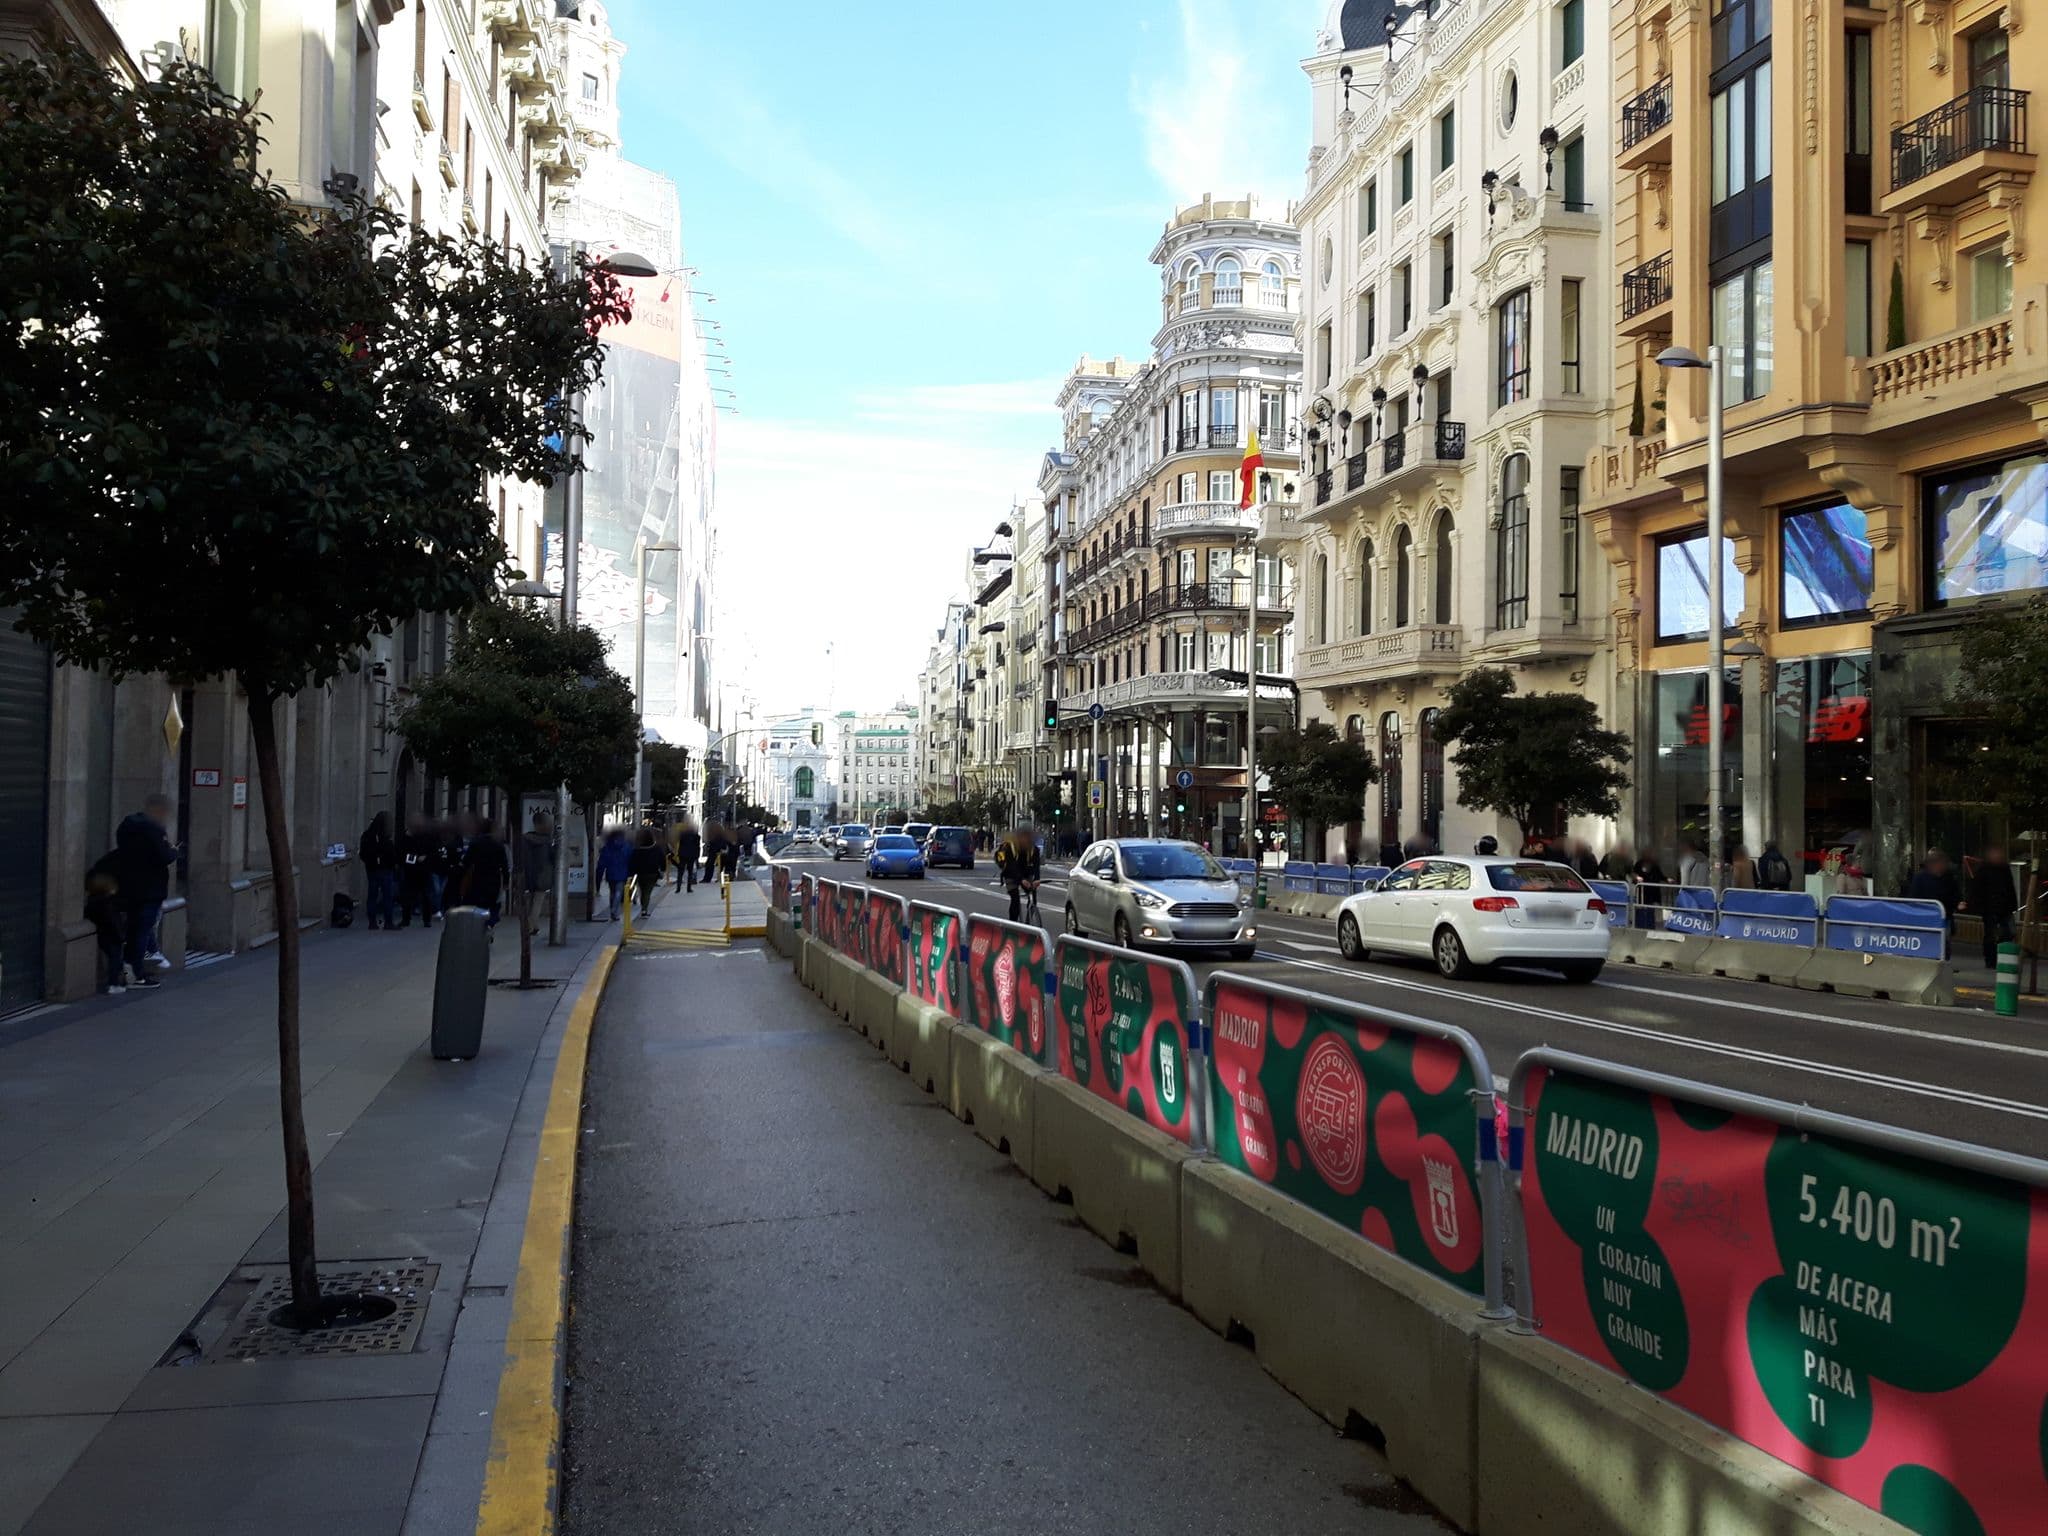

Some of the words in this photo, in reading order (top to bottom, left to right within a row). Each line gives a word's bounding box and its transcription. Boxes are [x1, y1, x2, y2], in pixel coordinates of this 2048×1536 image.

[1667, 913, 1713, 932] MADRID
[1869, 935, 1921, 951] MADRID
[1218, 1010, 1260, 1049] MADRID
[1546, 1111, 1644, 1181] MADRID
[1596, 1205, 1616, 1235] UN
[1799, 1174, 1896, 1249] 5.400
[1910, 1216, 1962, 1267] m²
[1599, 1241, 1662, 1290] CORAZÓN
[1602, 1276, 1632, 1311] MUY
[1796, 1260, 1823, 1297] DE
[1826, 1272, 1892, 1324] ACERA
[1608, 1312, 1663, 1360] GRANDE
[1799, 1304, 1838, 1346] MÁS
[1804, 1349, 1856, 1399] PARA
[1808, 1393, 1826, 1428] TI
